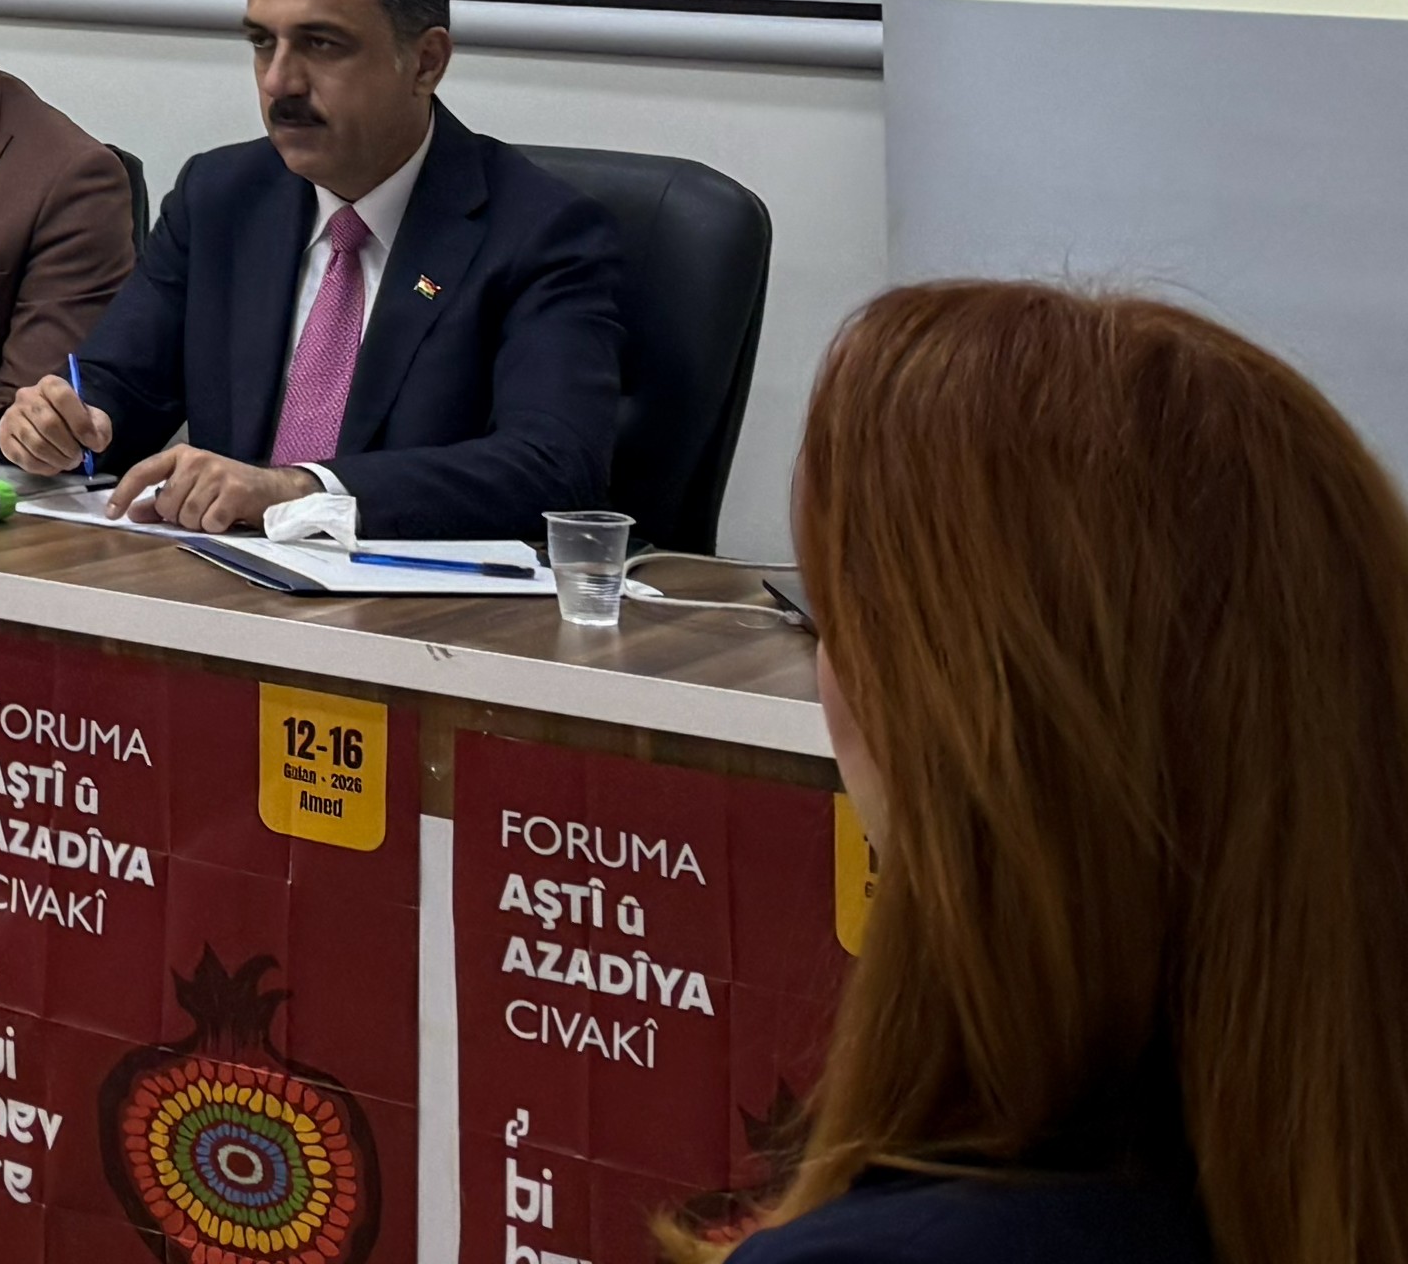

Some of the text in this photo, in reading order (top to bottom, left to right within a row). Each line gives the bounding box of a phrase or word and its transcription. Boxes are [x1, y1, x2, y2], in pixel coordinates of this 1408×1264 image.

[283, 717, 364, 770] 12-16
[75, 776, 100, 815] û
[300, 791, 343, 819] Amed
[330, 772, 362, 794] 2026
[501, 809, 707, 886] FORUMA
[498, 873, 645, 937] AŞTÎ û
[501, 935, 715, 1017] AZADÎYA
[505, 999, 659, 1069] CIVAKÎ
[505, 1156, 553, 1230] bi
